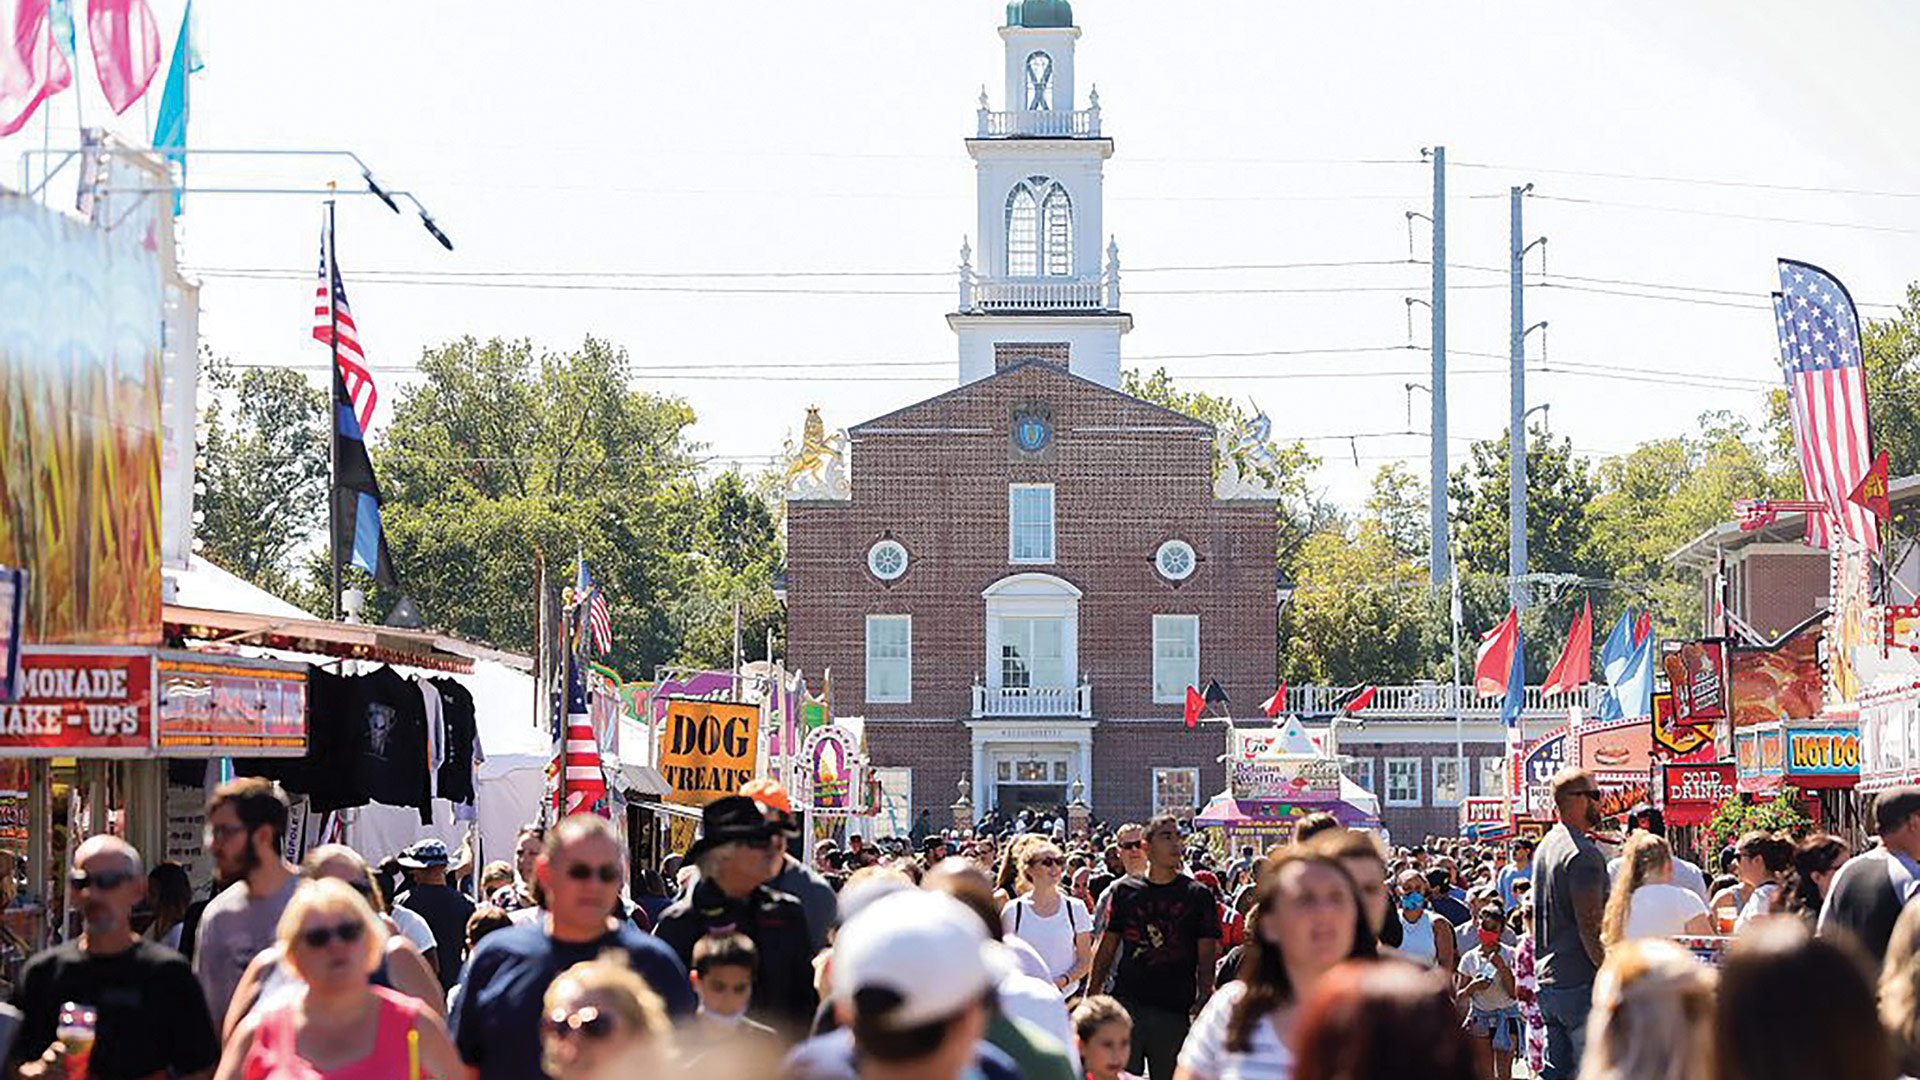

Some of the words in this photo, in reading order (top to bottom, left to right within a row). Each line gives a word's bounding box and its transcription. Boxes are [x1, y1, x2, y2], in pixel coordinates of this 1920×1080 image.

[671, 714, 749, 757] DOG
[1793, 736, 1829, 767] HOT
[1832, 735, 1860, 767] DO
[664, 765, 751, 792] TREATS
[1681, 771, 1721, 786] COLD
[1671, 785, 1734, 800] DRINKS
